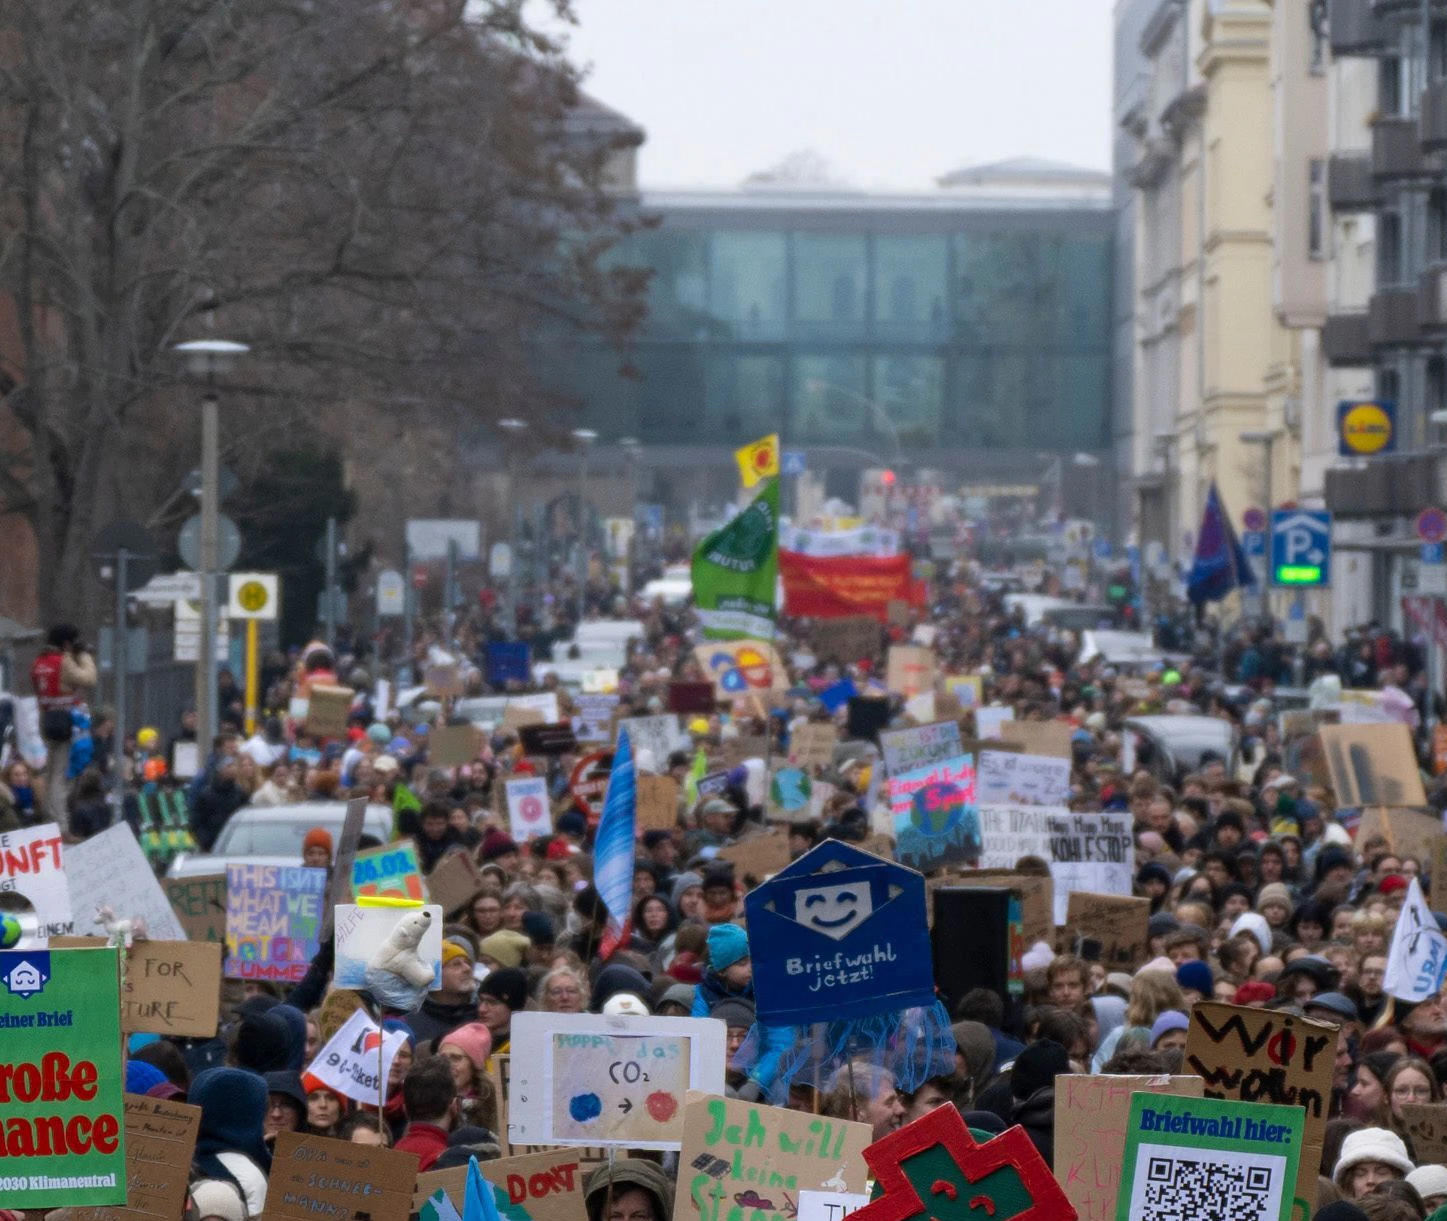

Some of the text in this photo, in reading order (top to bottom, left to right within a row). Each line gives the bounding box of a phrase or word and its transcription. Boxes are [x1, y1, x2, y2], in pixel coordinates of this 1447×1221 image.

[1286, 528, 1312, 563] P
[228, 864, 277, 888] THIS
[286, 891, 318, 917] WE
[37, 922, 74, 938] EINEM
[786, 942, 896, 975] Briefwahl
[145, 958, 192, 987] FOR
[809, 965, 874, 991] jetzt!
[37, 1010, 73, 1027] Brief
[1195, 1009, 1329, 1072] Wir
[1140, 1109, 1241, 1140] Briefwahl
[1245, 1118, 1292, 1144] hier:
[778, 1120, 848, 1161] will
[29, 1173, 116, 1190] Klimaneutral
